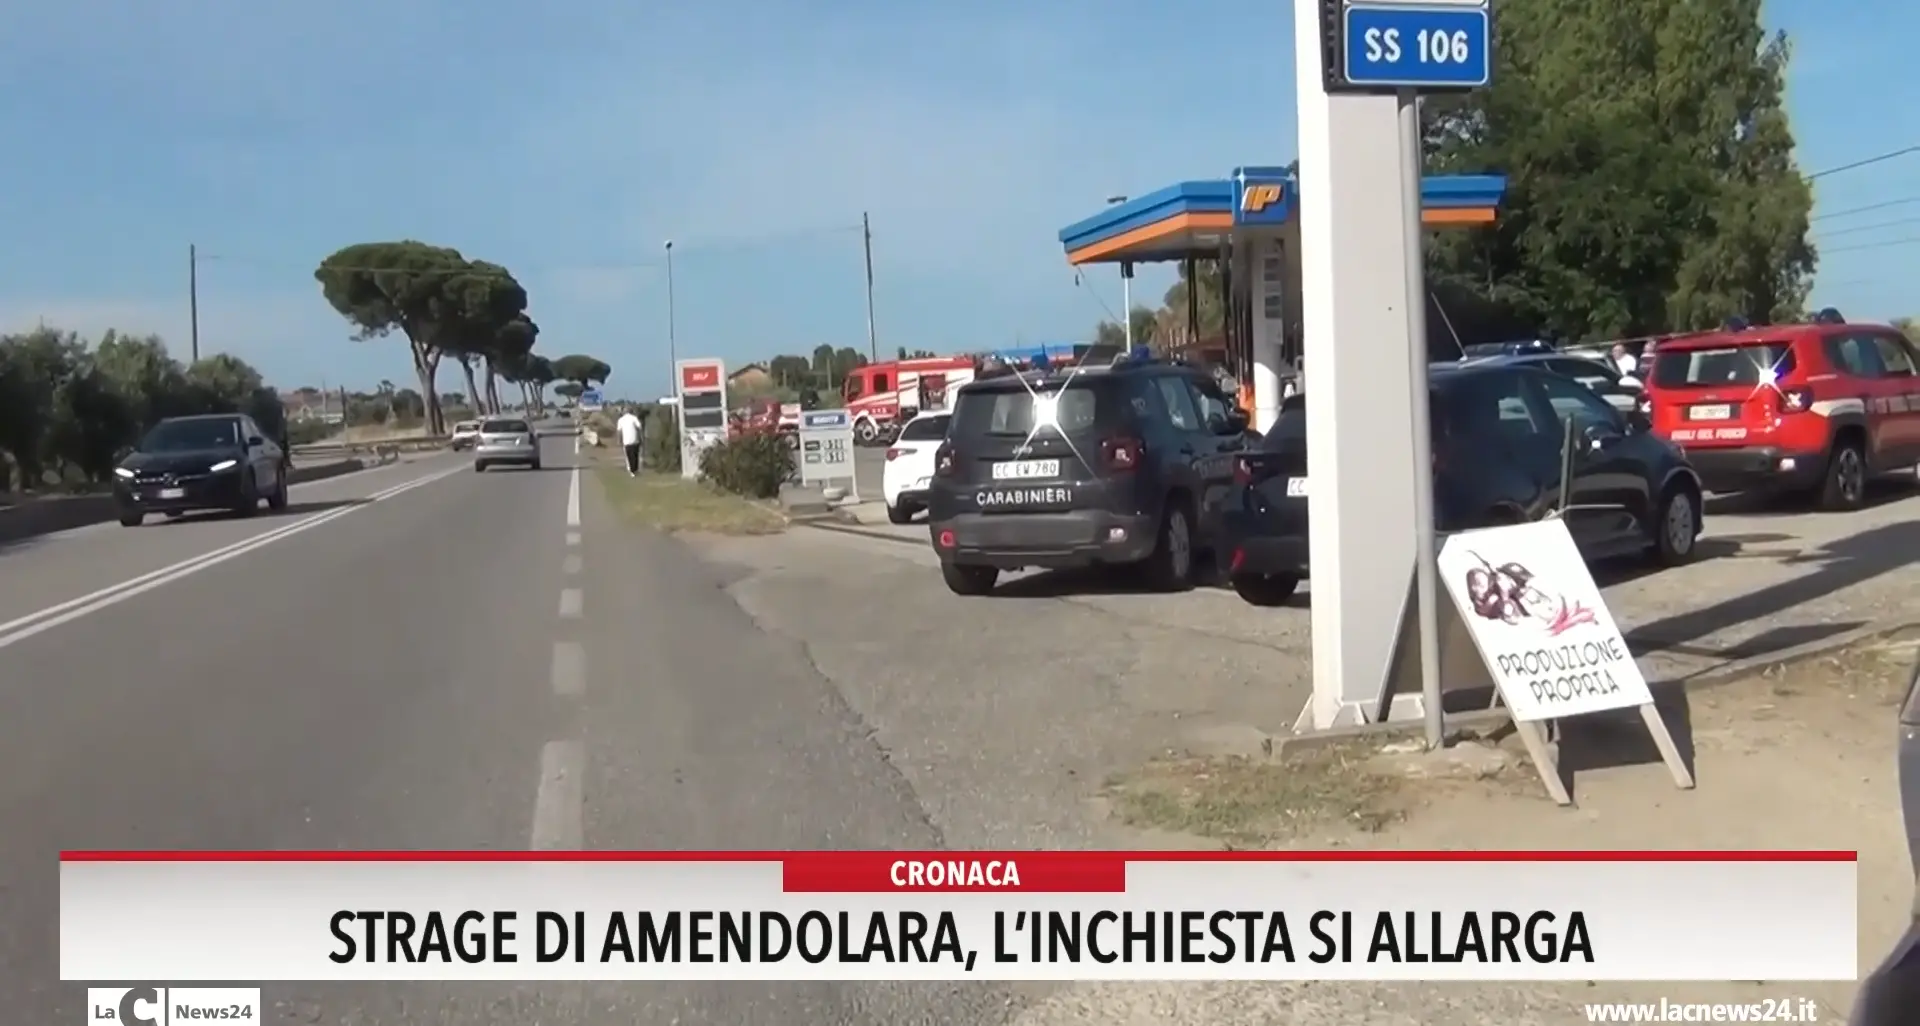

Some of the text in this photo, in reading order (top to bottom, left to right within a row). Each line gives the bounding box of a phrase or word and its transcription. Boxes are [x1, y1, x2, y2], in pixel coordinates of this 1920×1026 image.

[1364, 27, 1469, 64] SS 106
[1240, 184, 1282, 212] IP
[976, 488, 1072, 506] CARABINIERI
[1497, 637, 1623, 675] PRODUZIONE
[1530, 669, 1620, 705] PROPRIA
